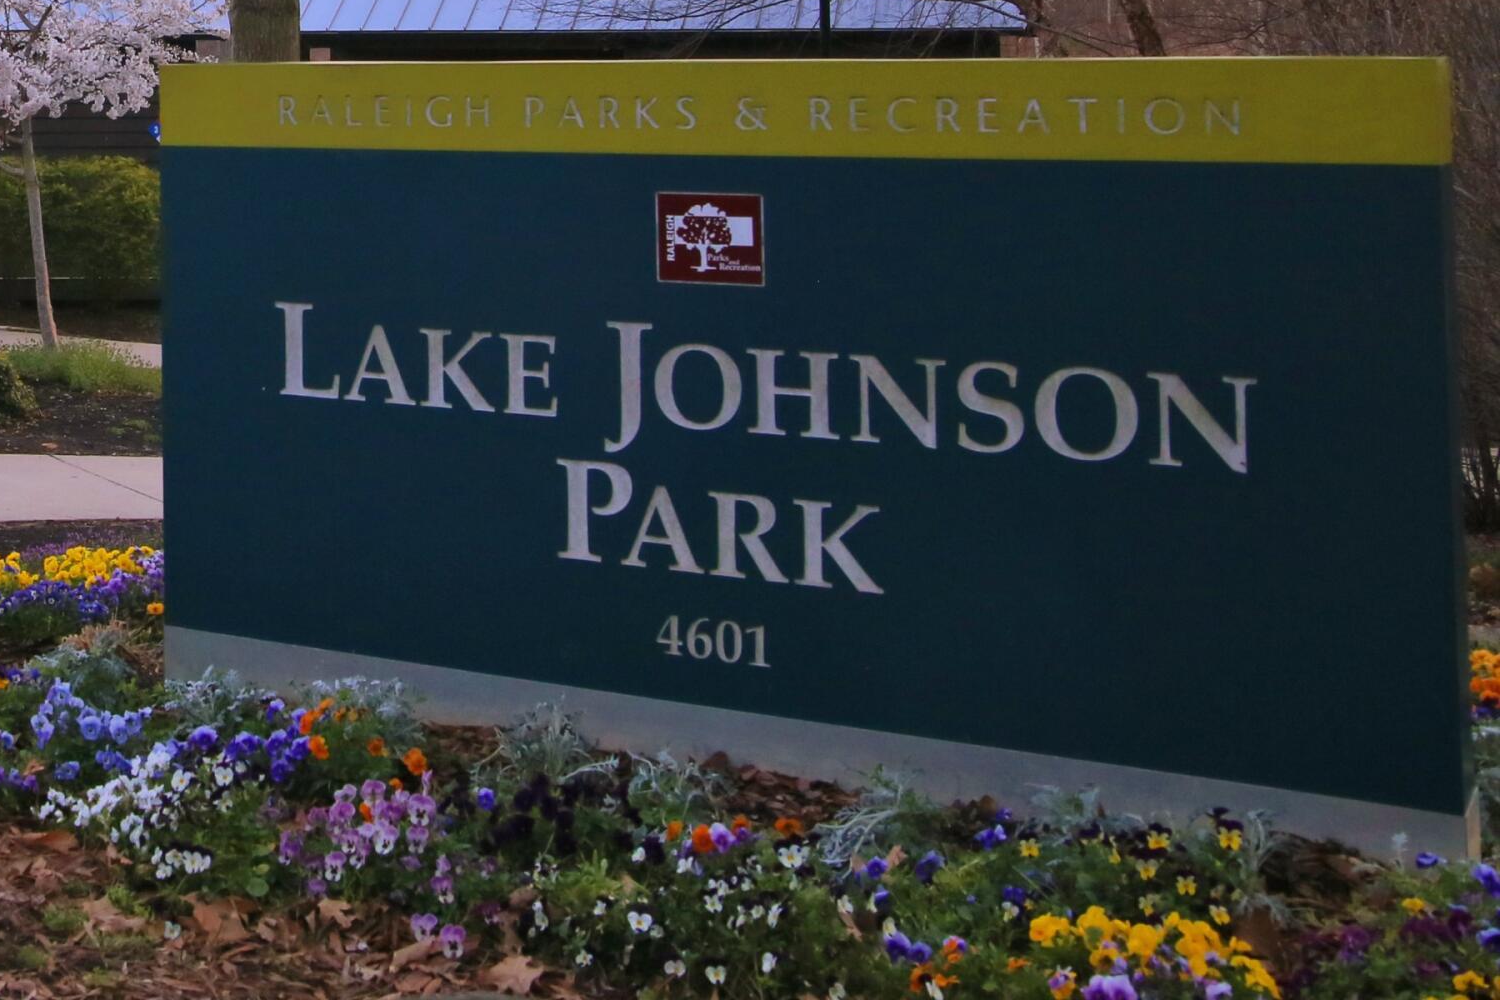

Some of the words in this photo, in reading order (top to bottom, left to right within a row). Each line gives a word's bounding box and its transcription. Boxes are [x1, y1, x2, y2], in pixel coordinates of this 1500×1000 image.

[278, 95, 491, 128] RALEIGH
[524, 96, 698, 131] PARKS
[733, 96, 769, 132] &
[808, 96, 1243, 136] RECREATION
[664, 214, 676, 262] RALEIGH
[707, 253, 730, 262] Parks
[718, 262, 762, 272] Recreation
[274, 301, 559, 418] LAKE
[604, 321, 1257, 475] JOHNSON
[556, 457, 885, 595] PARK
[657, 616, 771, 668] 4601
